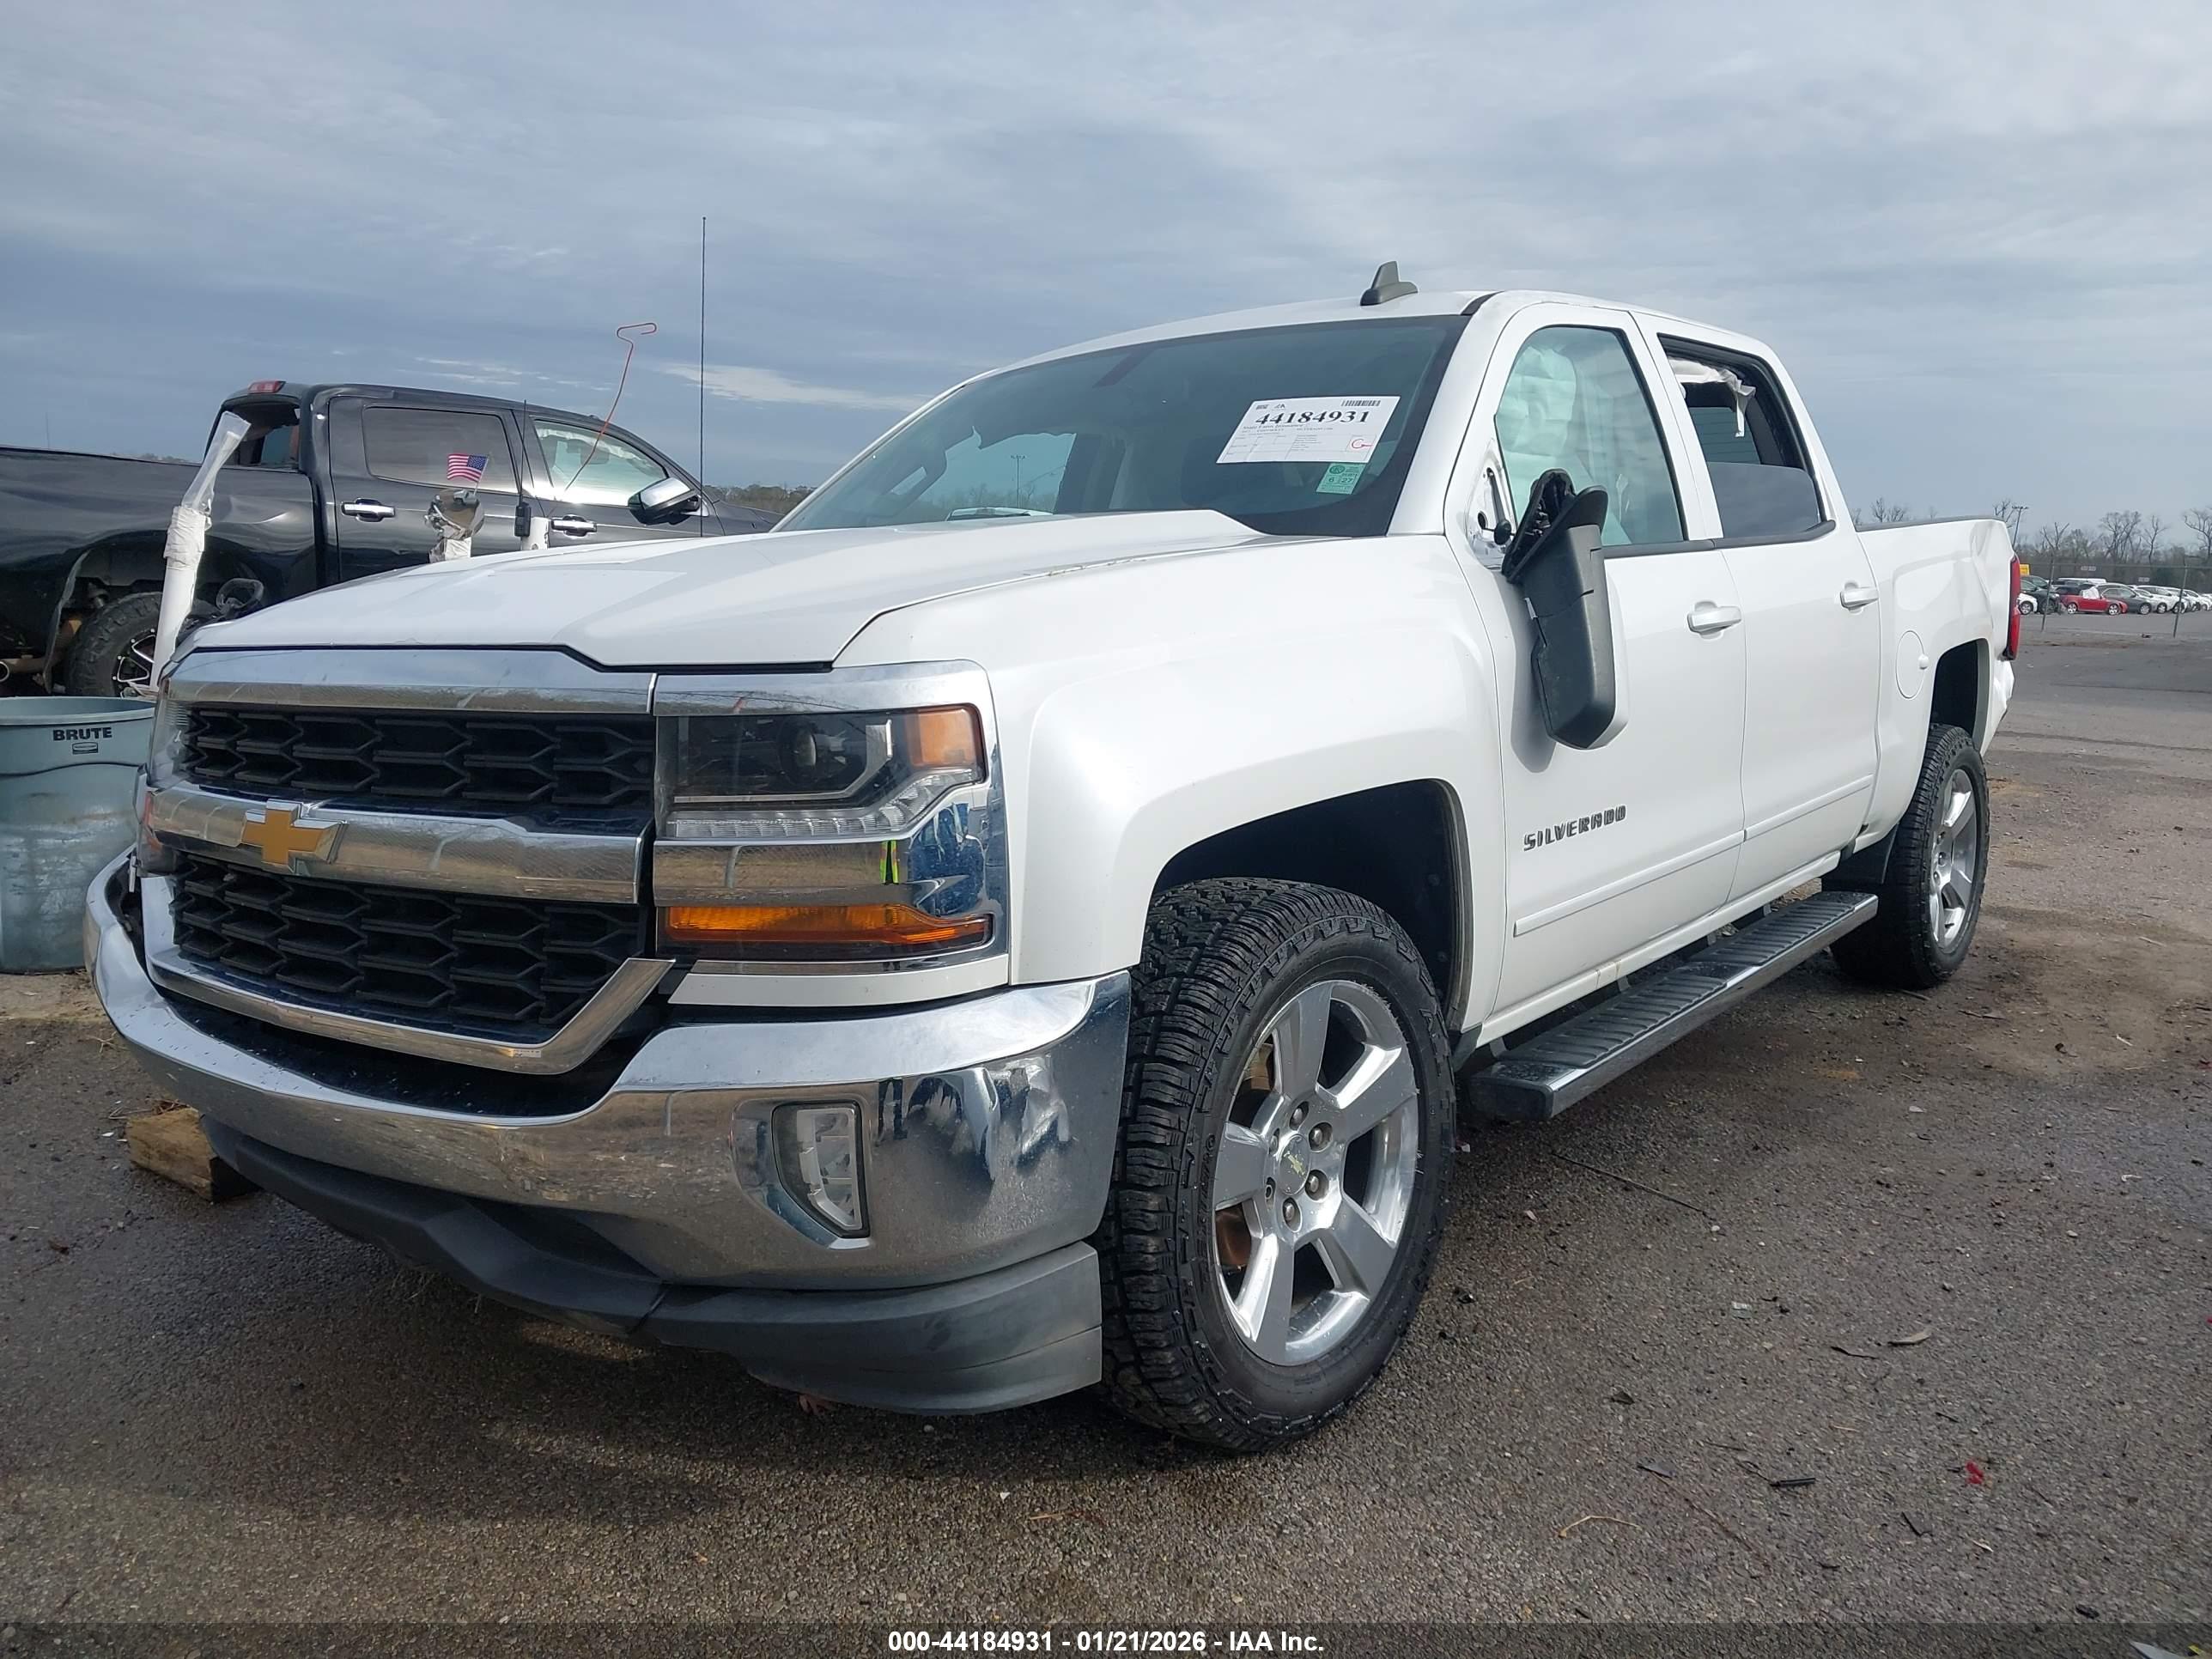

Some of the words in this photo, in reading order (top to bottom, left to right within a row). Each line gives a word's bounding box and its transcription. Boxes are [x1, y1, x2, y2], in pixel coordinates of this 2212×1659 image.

[1255, 411, 1370, 424] 44184931
[52, 726, 112, 741] BRUTE
[1523, 805, 1626, 852] SILVERADO
